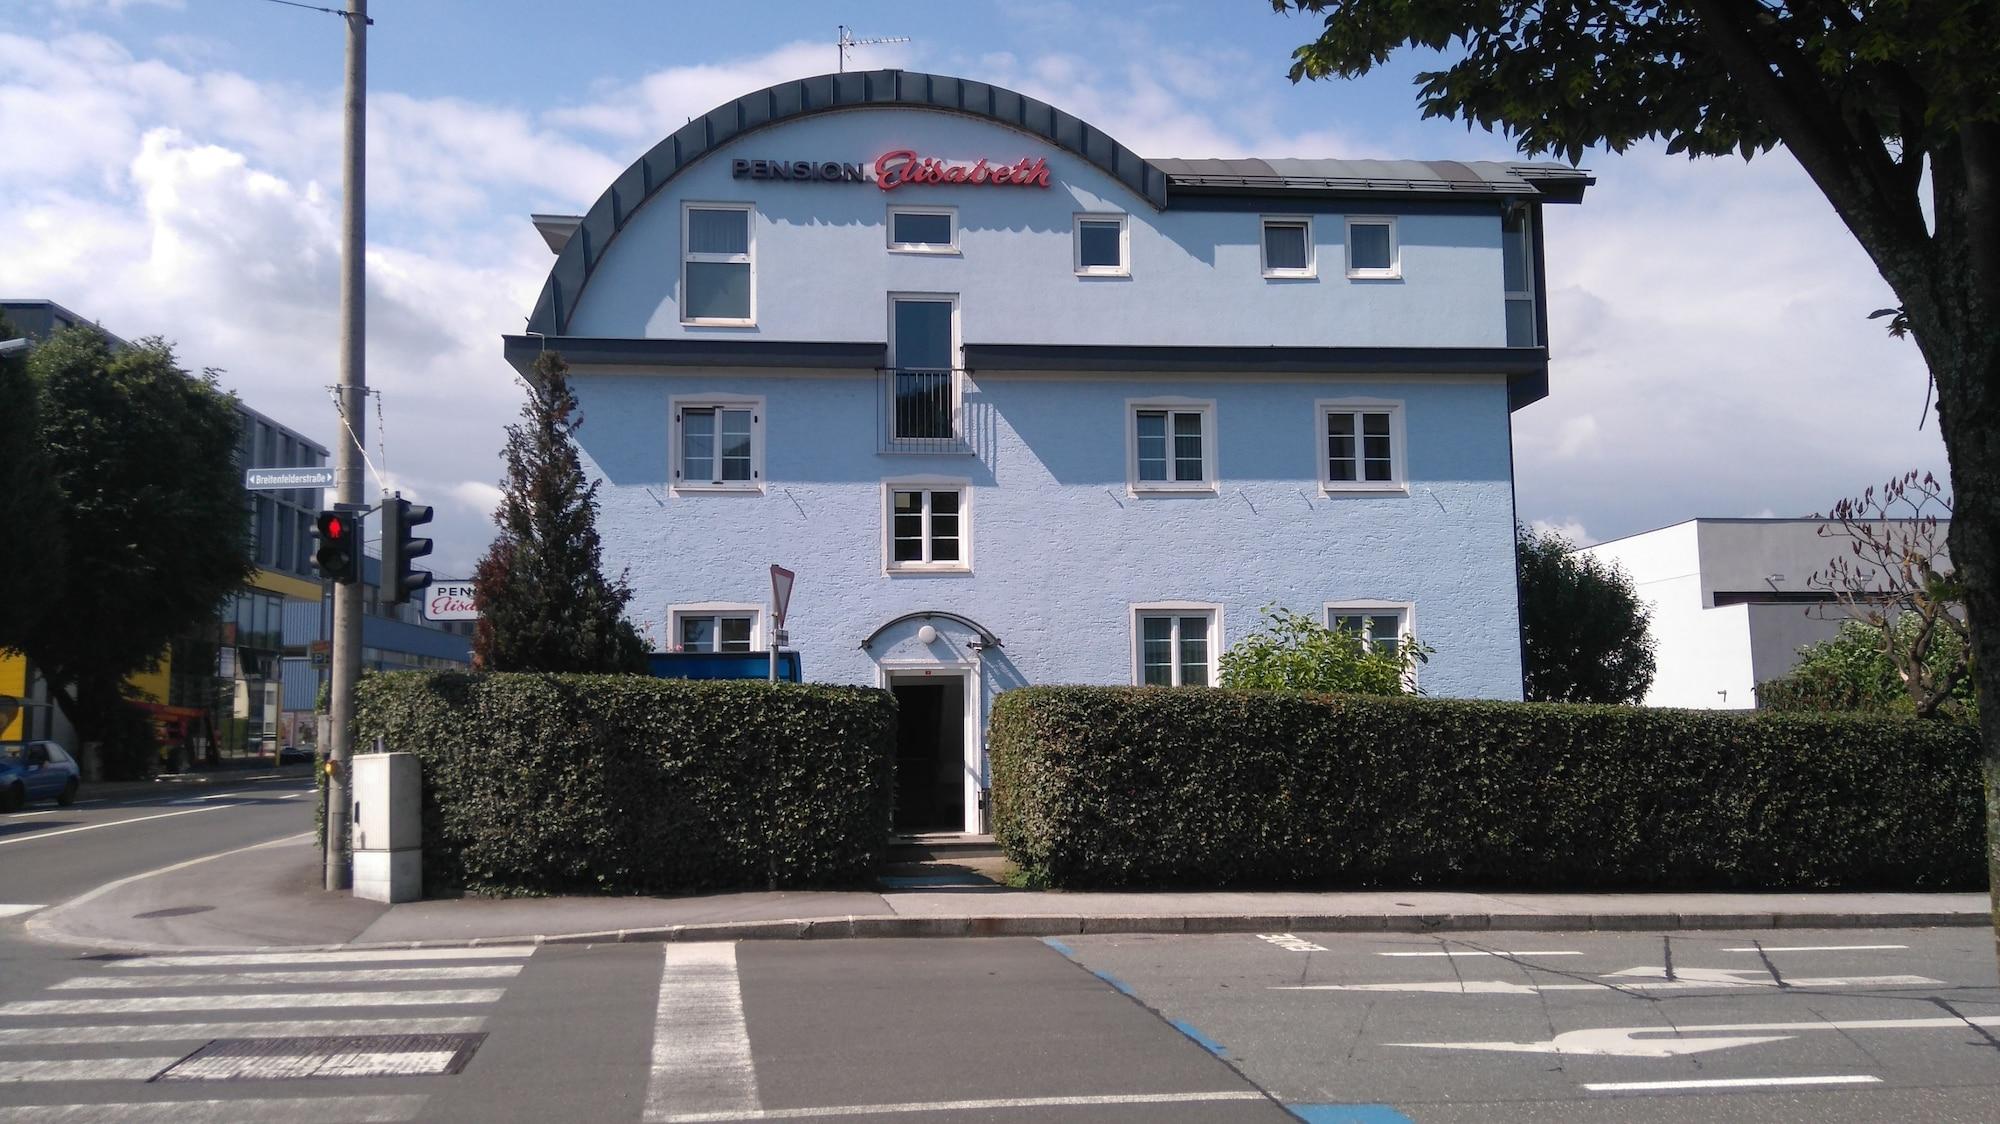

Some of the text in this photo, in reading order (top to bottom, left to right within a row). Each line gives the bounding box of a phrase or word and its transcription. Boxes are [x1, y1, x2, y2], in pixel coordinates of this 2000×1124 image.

[732, 150, 1051, 190] PENSION Elisabeth
[256, 473, 326, 485] Breitenfelderstraße
[437, 587, 473, 597] PEN
